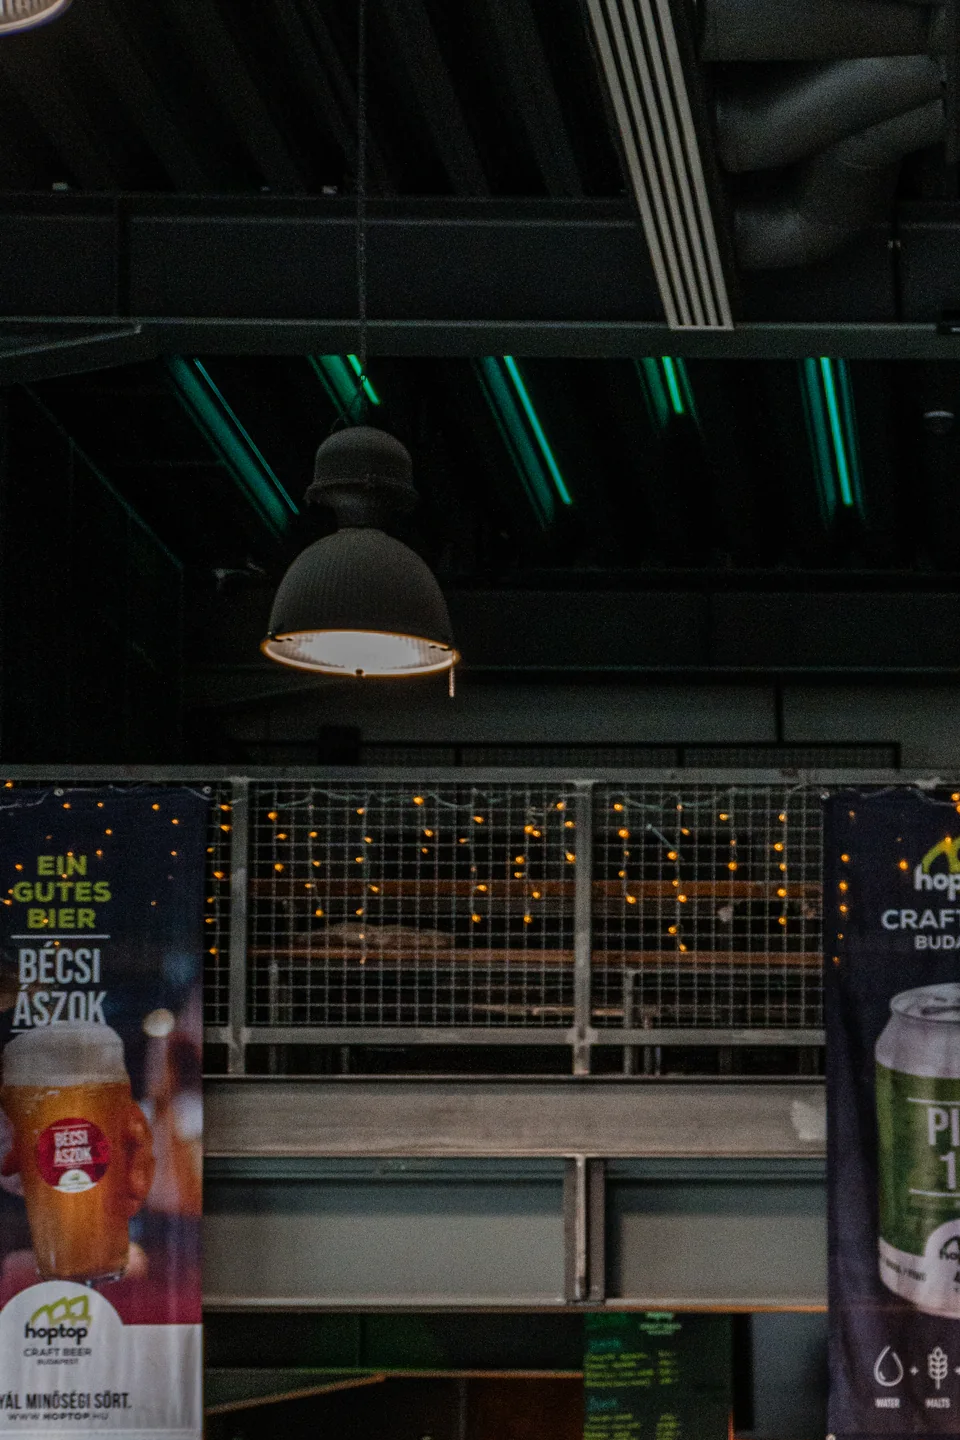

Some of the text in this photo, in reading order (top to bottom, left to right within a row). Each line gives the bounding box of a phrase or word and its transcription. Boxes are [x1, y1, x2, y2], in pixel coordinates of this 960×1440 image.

[37, 855, 87, 876] EIN
[12, 882, 112, 902] GUTES
[27, 908, 96, 929] BIER
[18, 941, 101, 985] BÉCSI
[12, 984, 108, 1027] ÁSZOK
[24, 1321, 88, 1346] hoptop
[23, 1347, 93, 1357] CRAFT BEER
